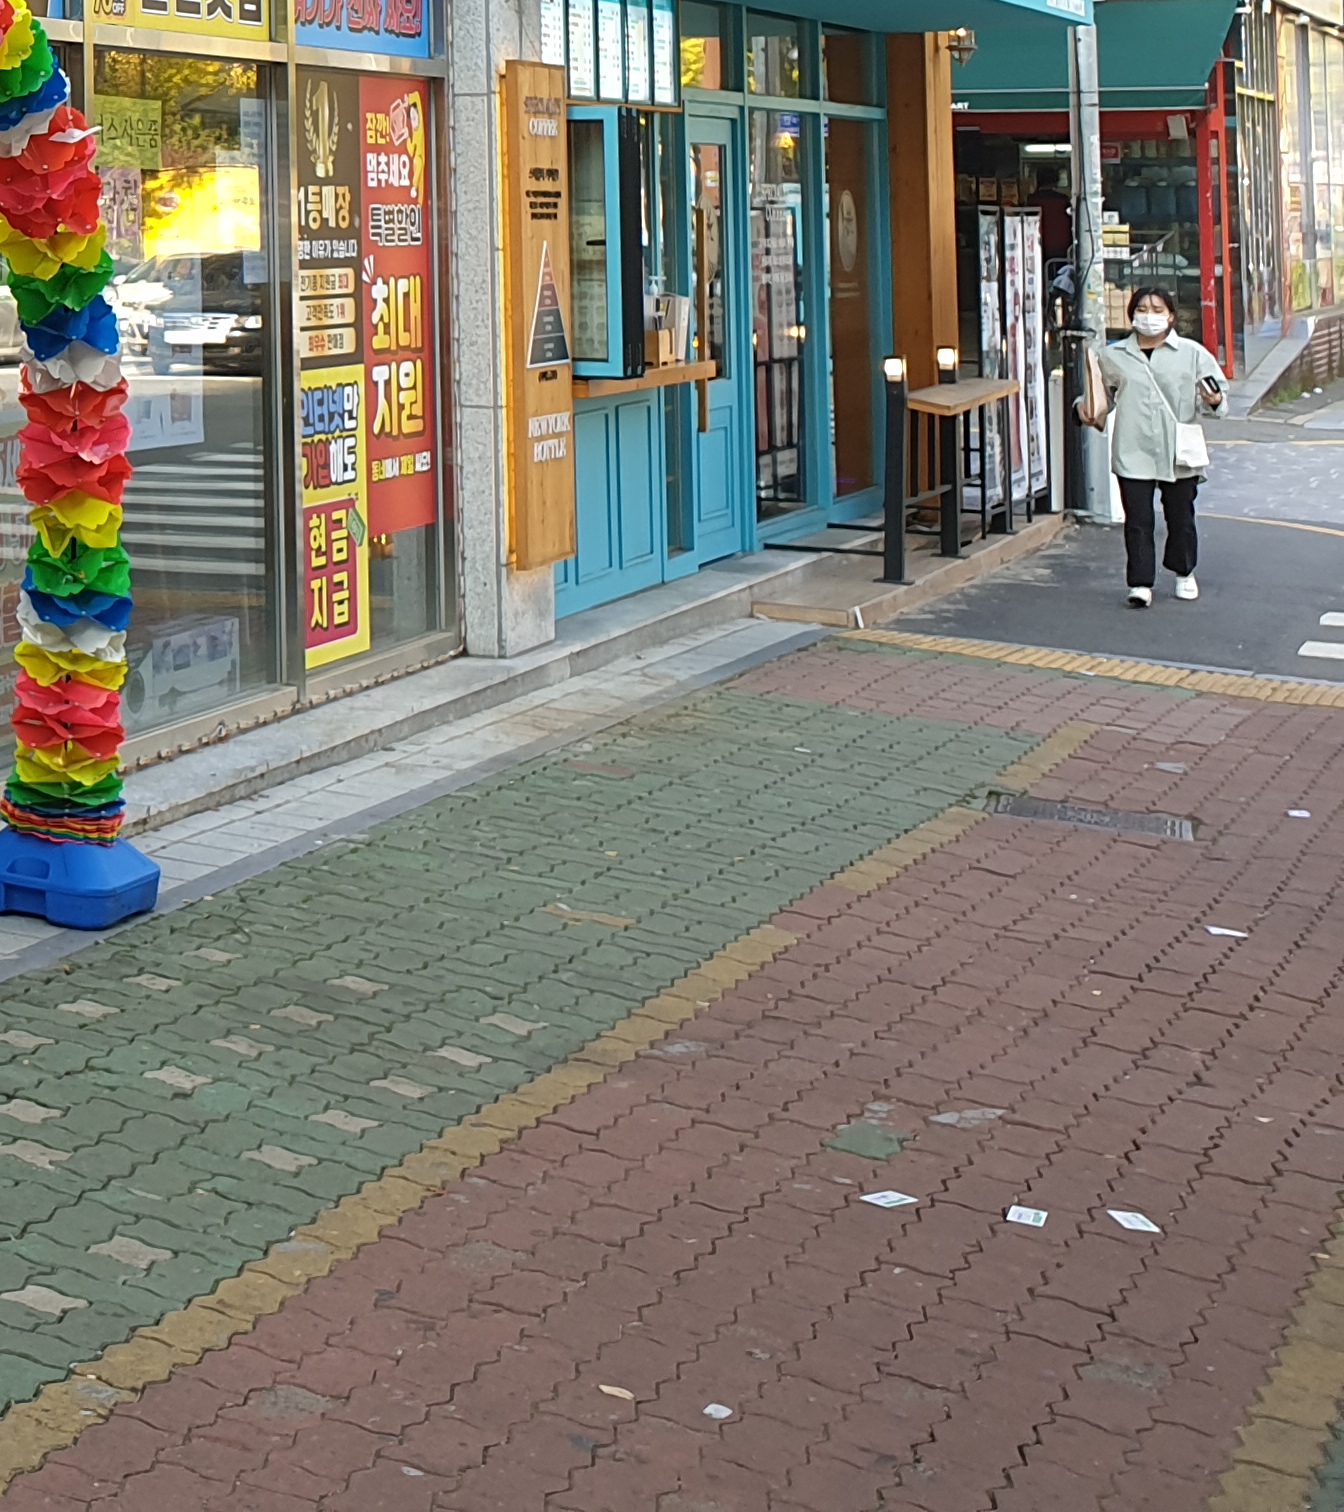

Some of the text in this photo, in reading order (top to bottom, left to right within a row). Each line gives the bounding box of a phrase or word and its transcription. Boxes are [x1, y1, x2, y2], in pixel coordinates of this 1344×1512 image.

[366, 152, 411, 188] 멈추세요
[370, 204, 422, 246] 특별할인
[371, 276, 422, 350] 최대
[372, 359, 423, 436] 지원
[309, 509, 348, 568] 현금
[311, 571, 349, 628] 지급
